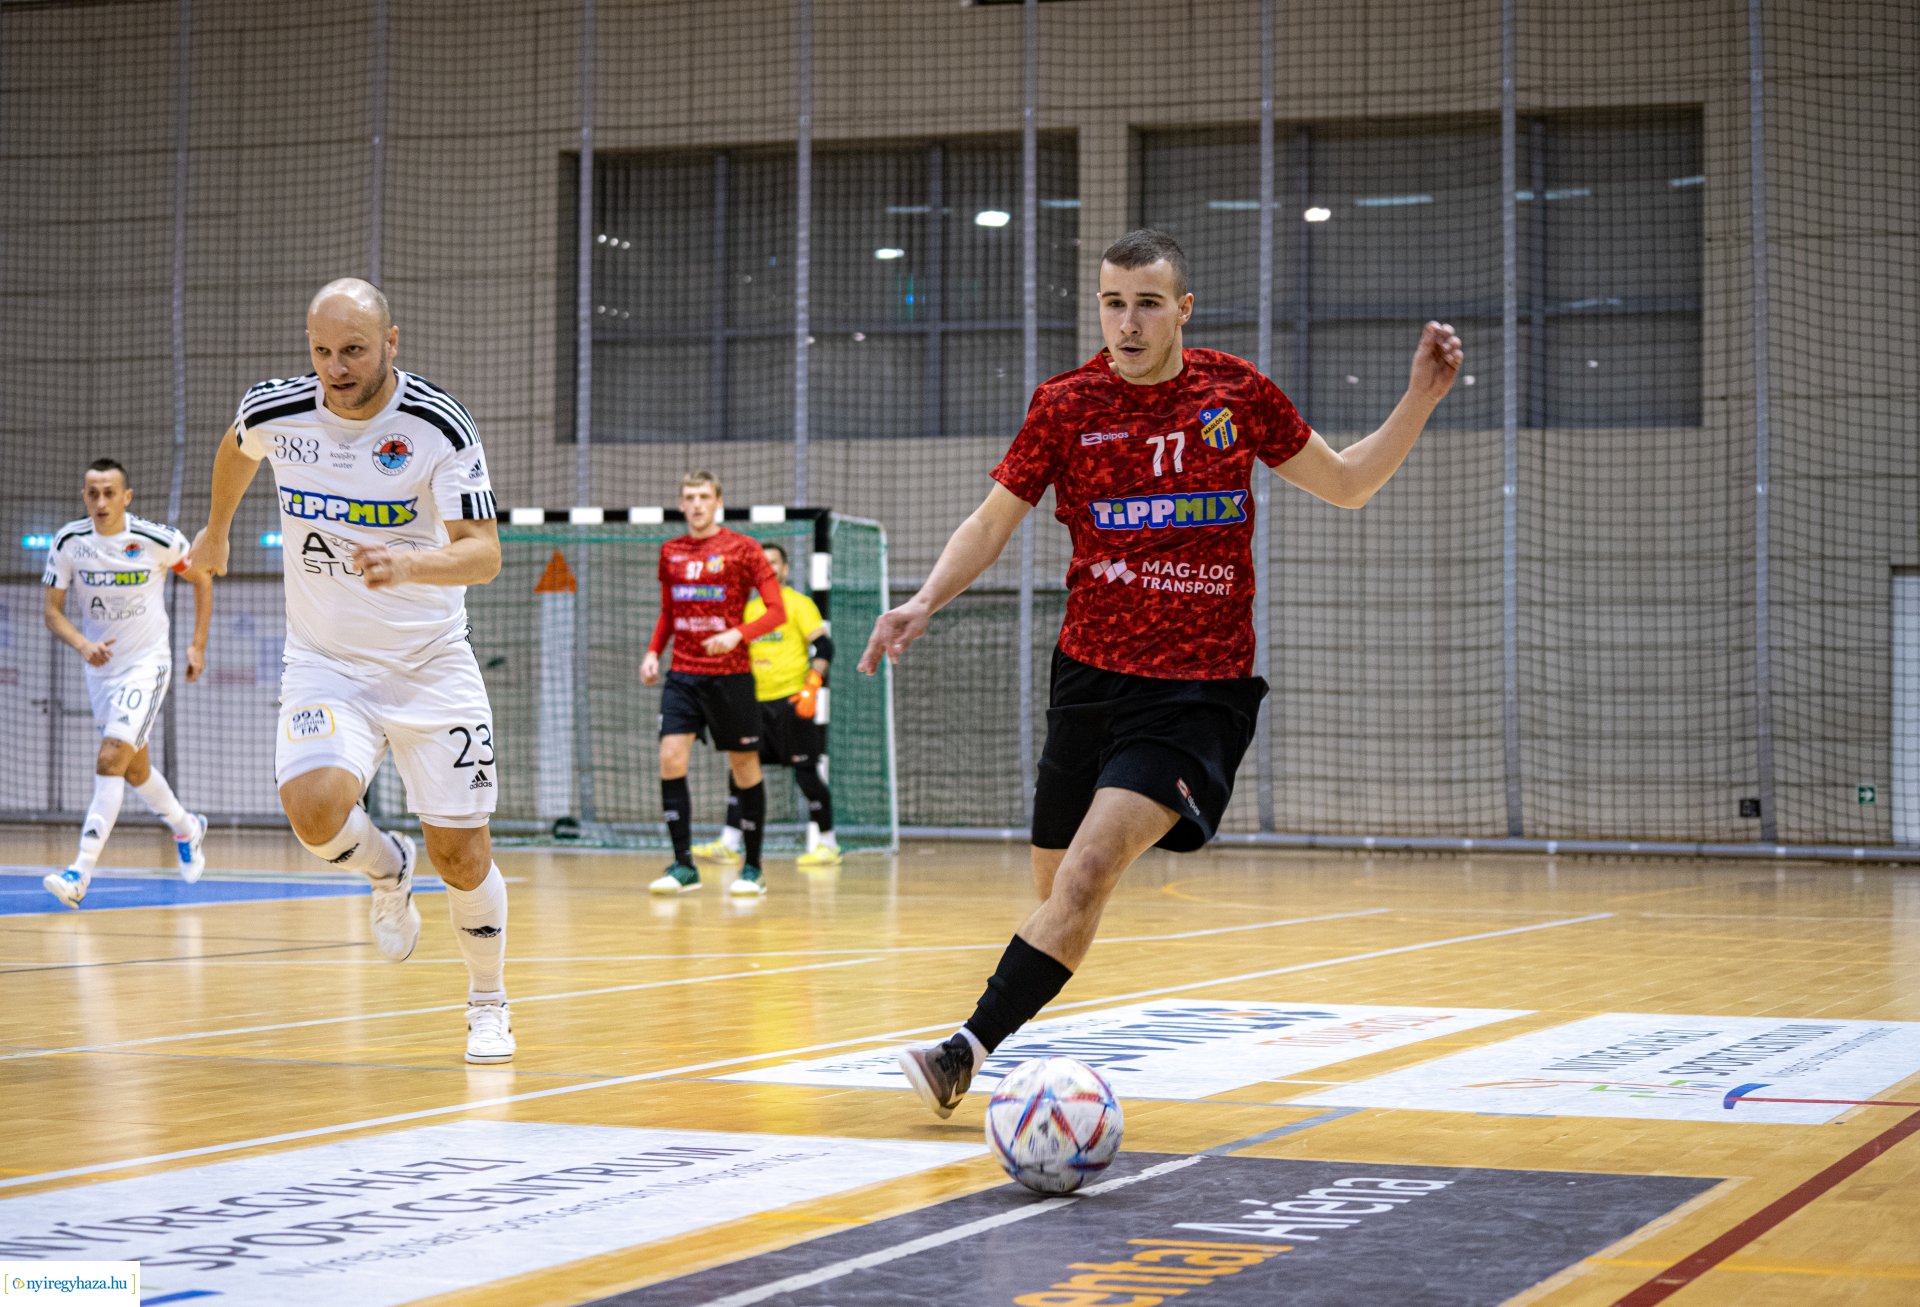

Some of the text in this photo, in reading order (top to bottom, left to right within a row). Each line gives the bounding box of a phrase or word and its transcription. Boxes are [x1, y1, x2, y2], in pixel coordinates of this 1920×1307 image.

[1103, 432, 1129, 441] alpas
[274, 434, 320, 464] 383
[1146, 431, 1185, 477] 77
[1142, 560, 1234, 580] MAG-LOG
[1142, 576, 1233, 596] TRANSPORT
[91, 605, 146, 621] STUDIO
[118, 689, 142, 710] 10
[449, 724, 494, 768] 23
[469, 781, 493, 790] adidas
[1172, 1176, 1457, 1242] Aréna
